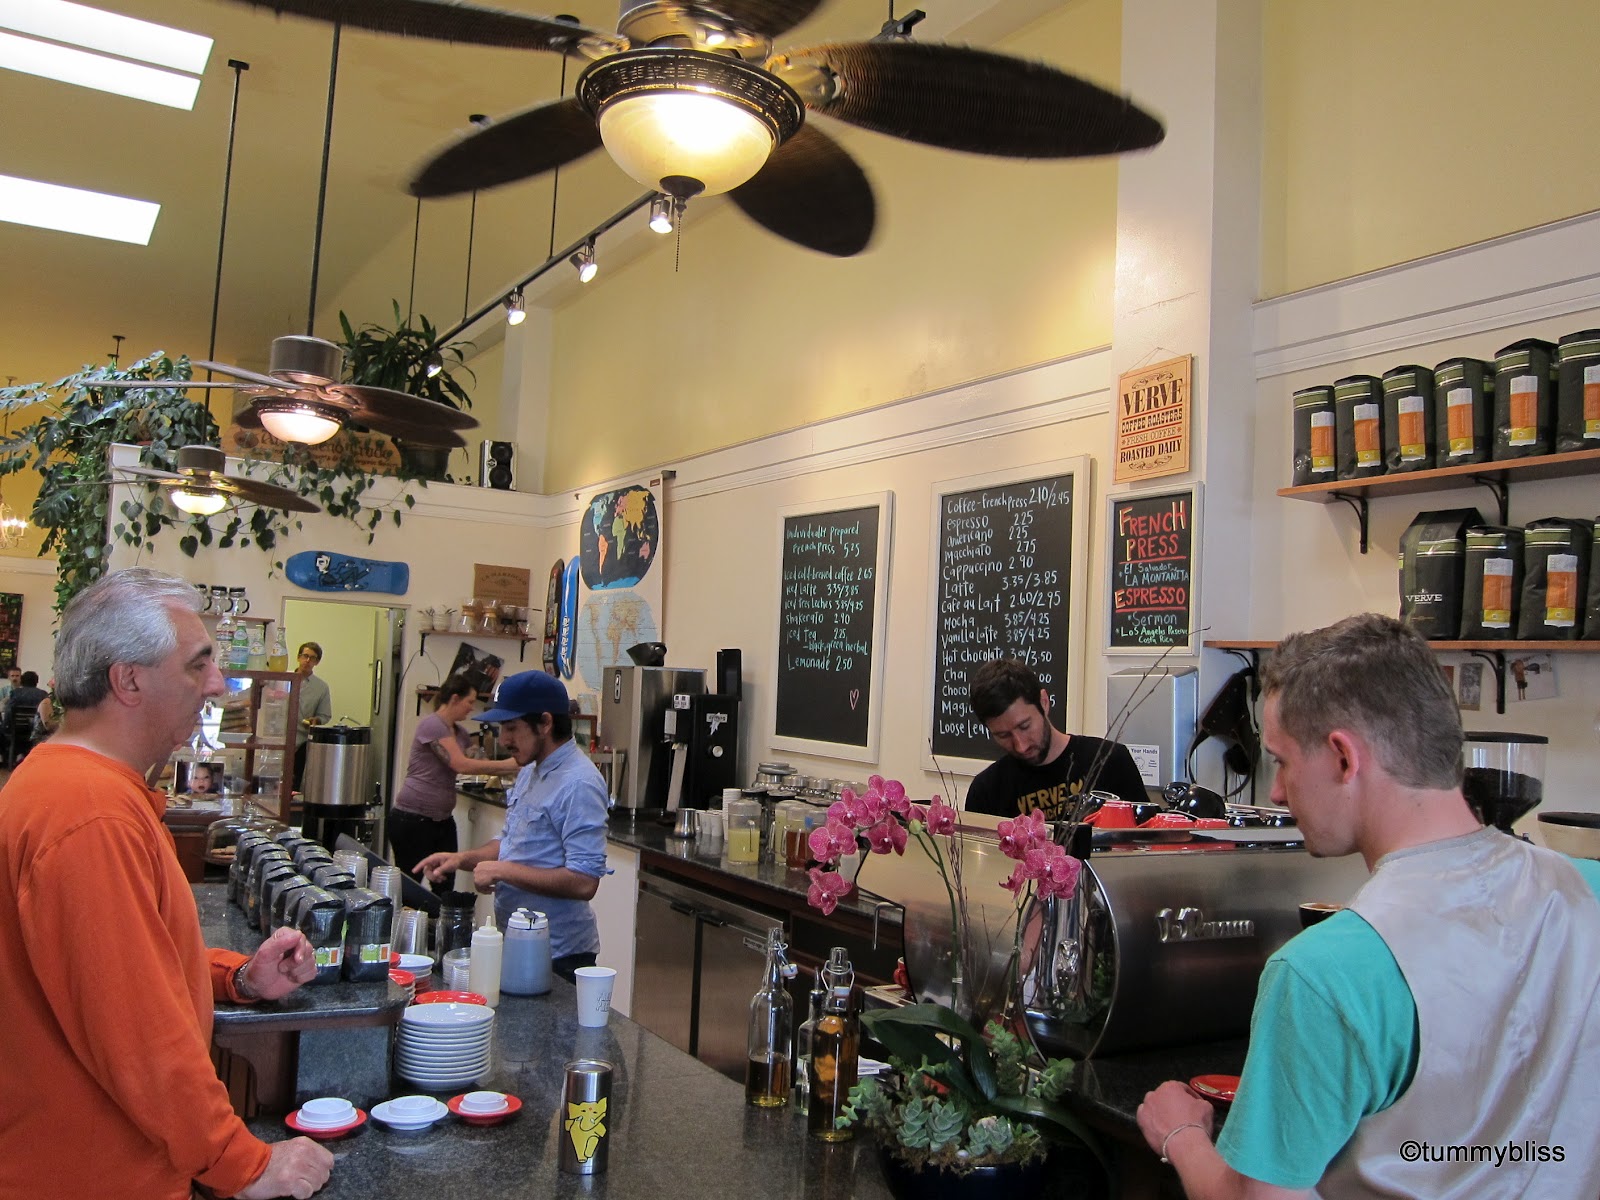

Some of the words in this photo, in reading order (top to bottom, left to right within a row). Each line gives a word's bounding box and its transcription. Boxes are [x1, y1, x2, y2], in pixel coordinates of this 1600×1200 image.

[1123, 378, 1183, 416] VERVE
[1121, 417, 1146, 434] COFFEE
[1147, 408, 1183, 427] ROASTERS
[1126, 433, 1149, 445] FRESH
[1150, 426, 1177, 439] COFFEE
[1120, 444, 1155, 463] ROASTED
[1158, 439, 1183, 456] DAILY
[1119, 500, 1187, 536] FRENCH
[1126, 533, 1179, 561] PRESS
[1124, 563, 1133, 575] El
[1137, 562, 1171, 573] Salvador
[945, 580, 975, 599] Latte
[1001, 570, 1058, 591] 3.35/3.85
[1124, 574, 1139, 587] LA
[963, 600, 975, 611] au
[978, 593, 1001, 613] Lait
[1009, 589, 1061, 609] 2.60/2.95
[1114, 587, 1186, 609] ESPRESSO
[1405, 593, 1443, 602] VERVE
[1131, 610, 1178, 627] Sermon
[1138, 635, 1157, 644] Costa
[1159, 635, 1174, 644] Rica
[942, 647, 958, 666] Hot
[943, 667, 967, 682] Chai
[942, 683, 971, 697] Chocol
[940, 719, 965, 737] Loose
[1017, 783, 1068, 815] VERVE
